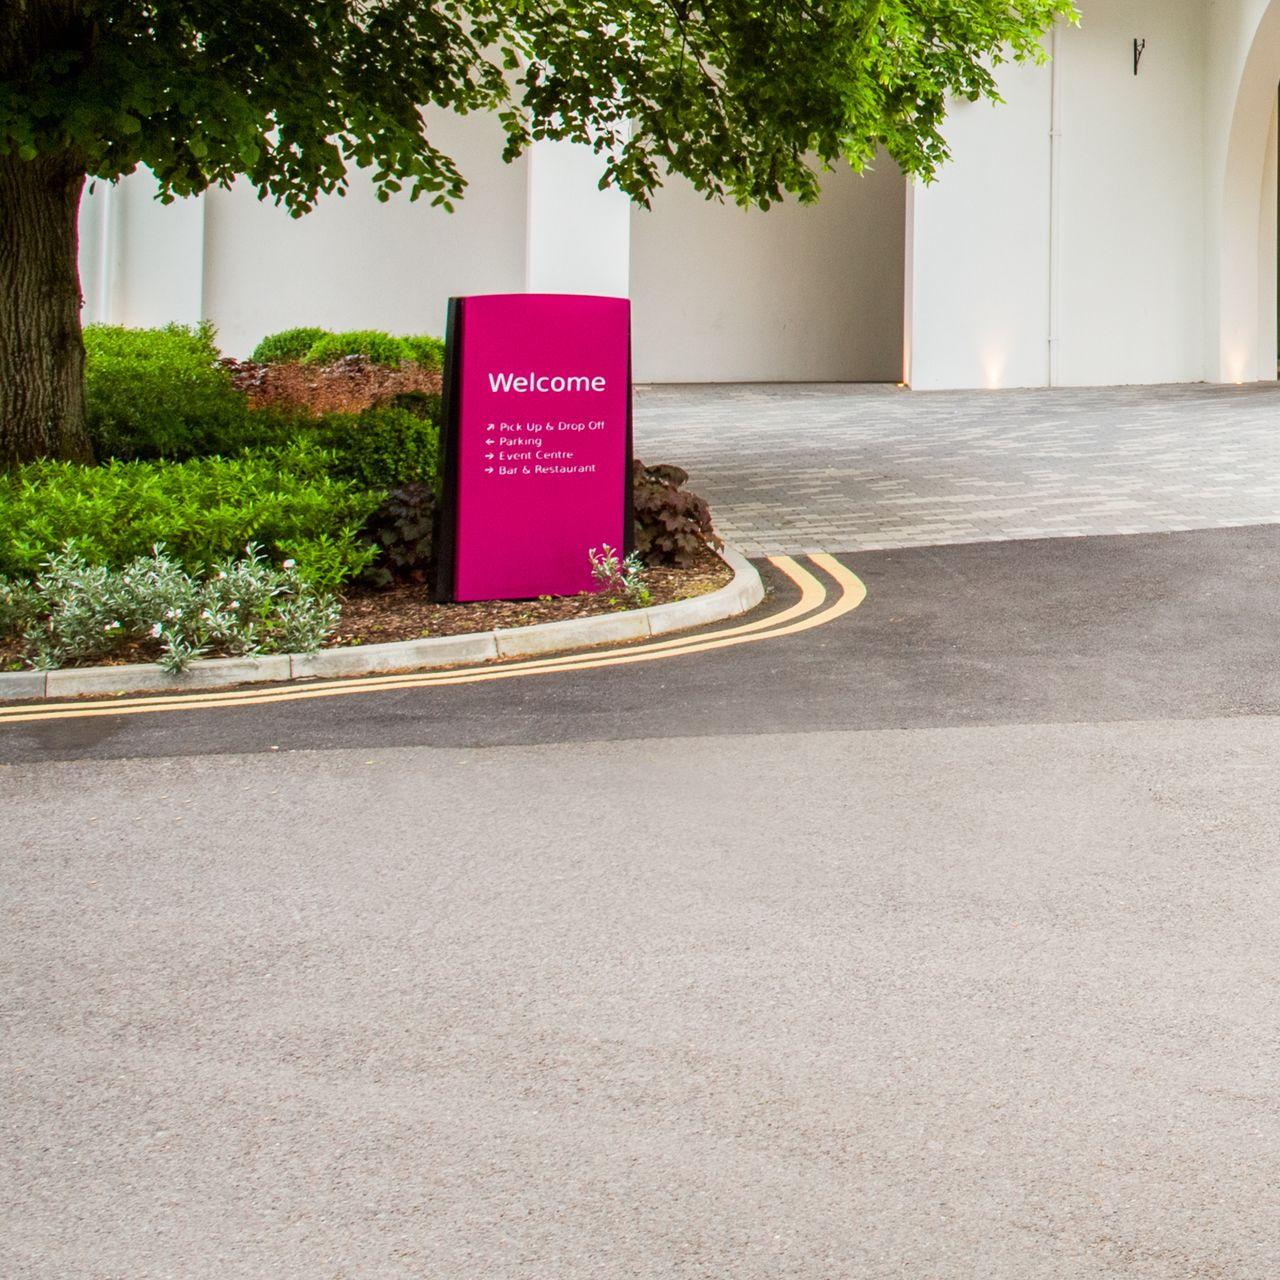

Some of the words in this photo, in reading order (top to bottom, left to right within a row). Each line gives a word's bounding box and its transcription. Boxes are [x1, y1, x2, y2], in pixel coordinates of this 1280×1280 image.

[489, 372, 606, 393] Welcome
[500, 421, 523, 432] Pick
[527, 421, 542, 433] Up
[545, 421, 554, 432] &
[558, 421, 585, 433] Drop
[589, 420, 605, 431] Off
[500, 436, 542, 448] Parking
[499, 451, 531, 461] Event
[536, 450, 573, 461] Centre
[499, 465, 517, 475] Bar
[522, 465, 531, 475] &
[535, 463, 596, 475] Restaurant
